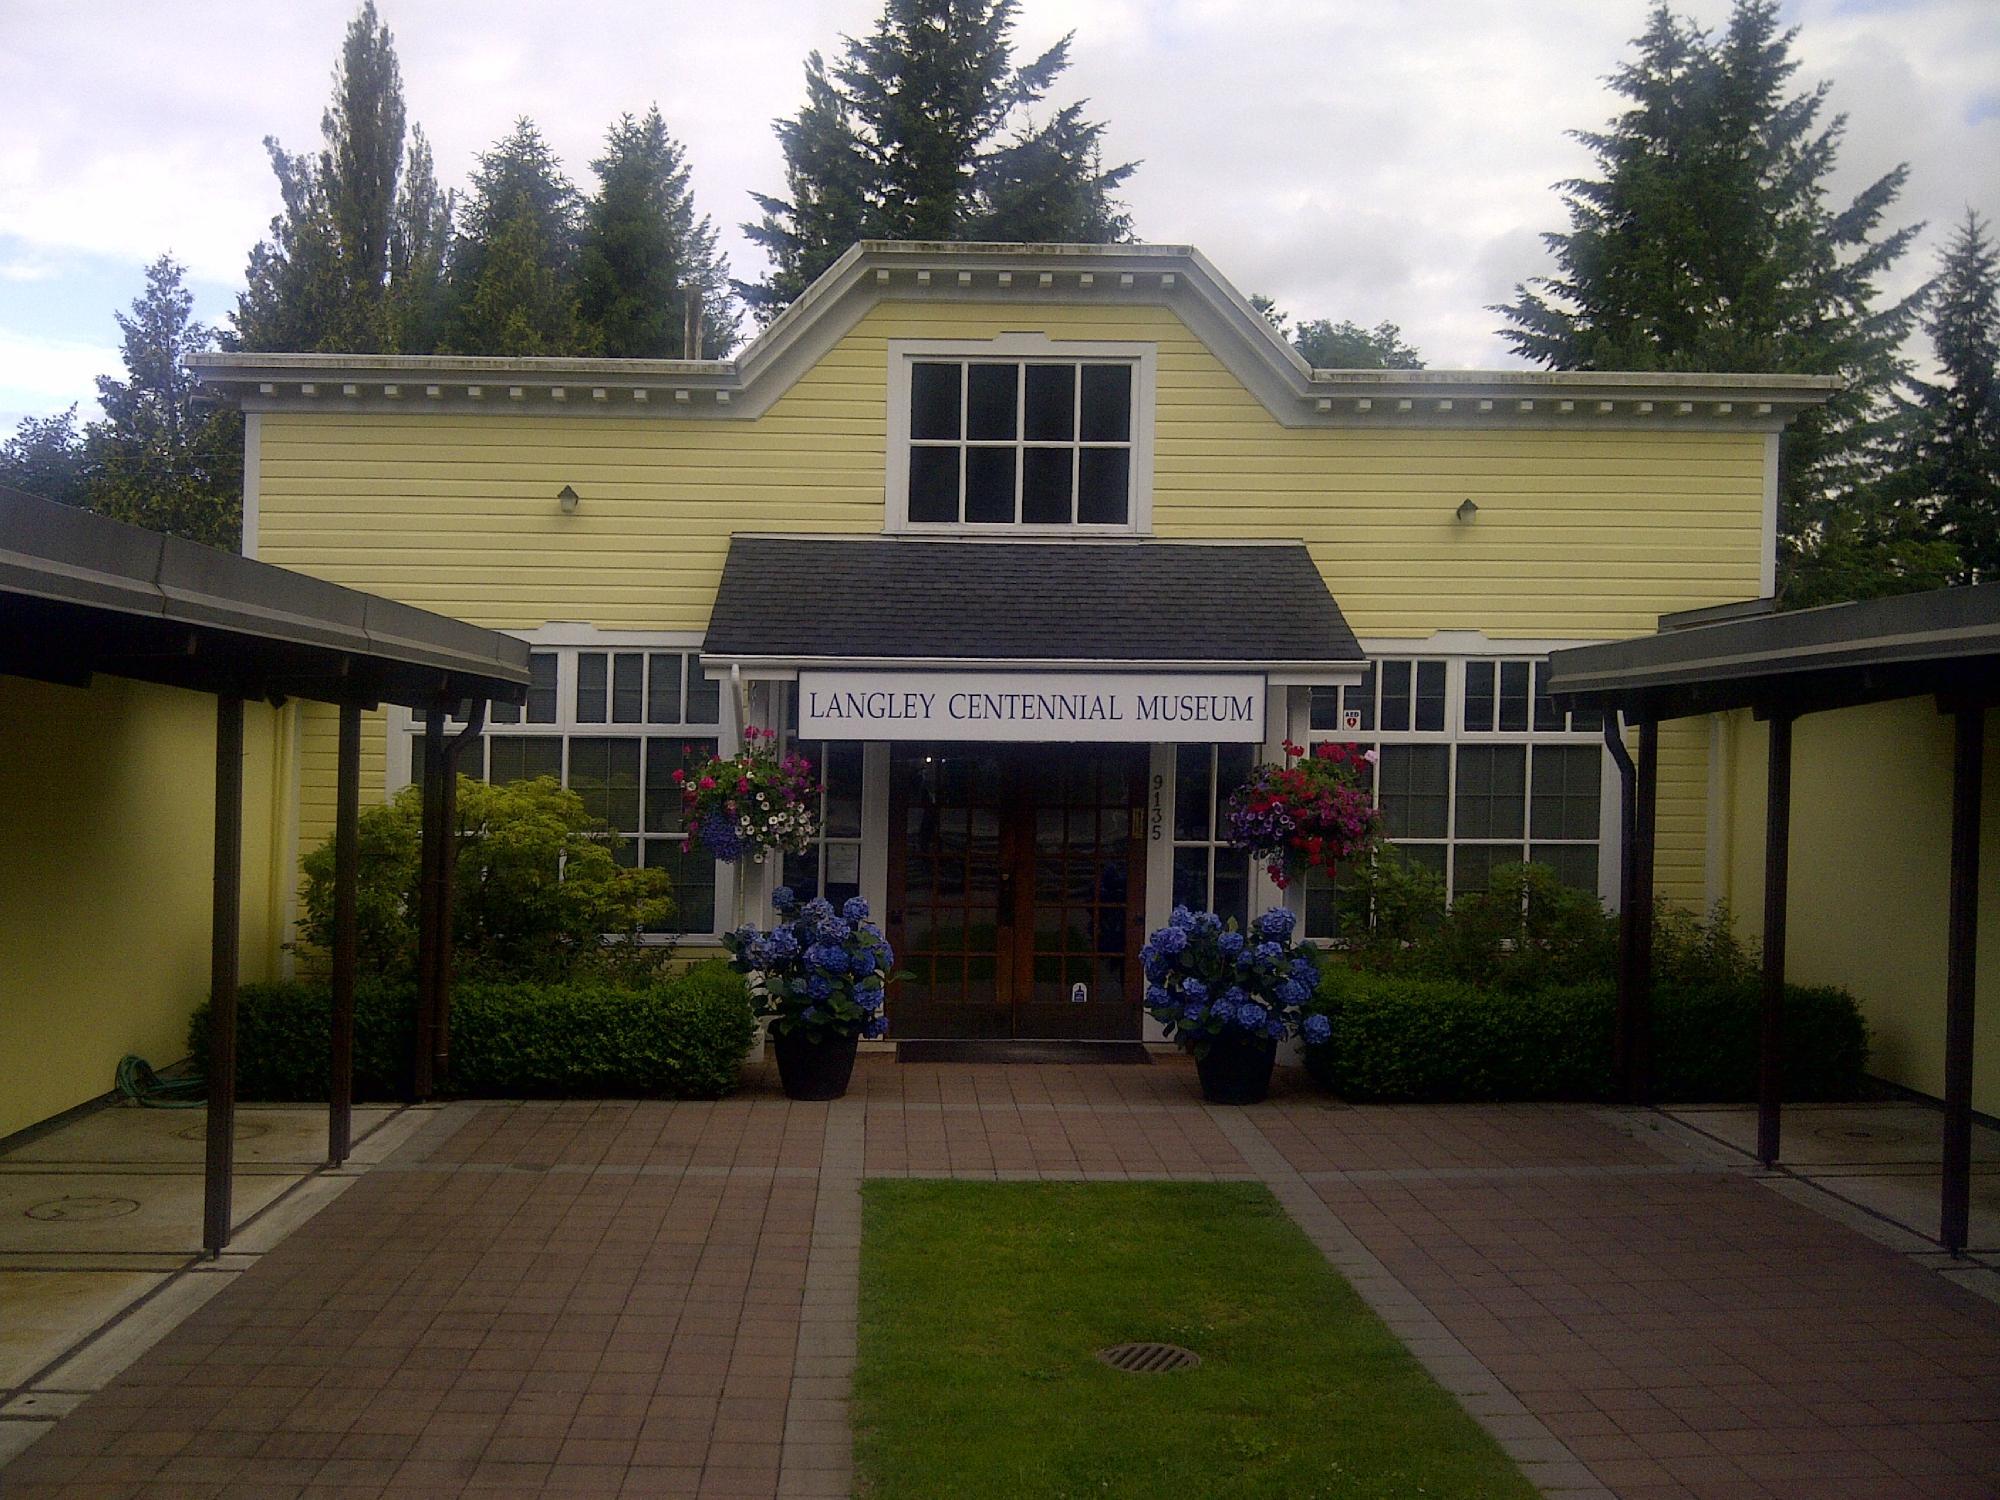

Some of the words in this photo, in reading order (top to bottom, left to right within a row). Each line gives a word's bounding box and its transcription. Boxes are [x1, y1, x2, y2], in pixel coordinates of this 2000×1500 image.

[810, 692, 936, 720] LANGLEY
[948, 693, 1123, 721] CENTENNIAL
[1136, 695, 1254, 722] MUSEUM
[1151, 774, 1163, 840] 9135
